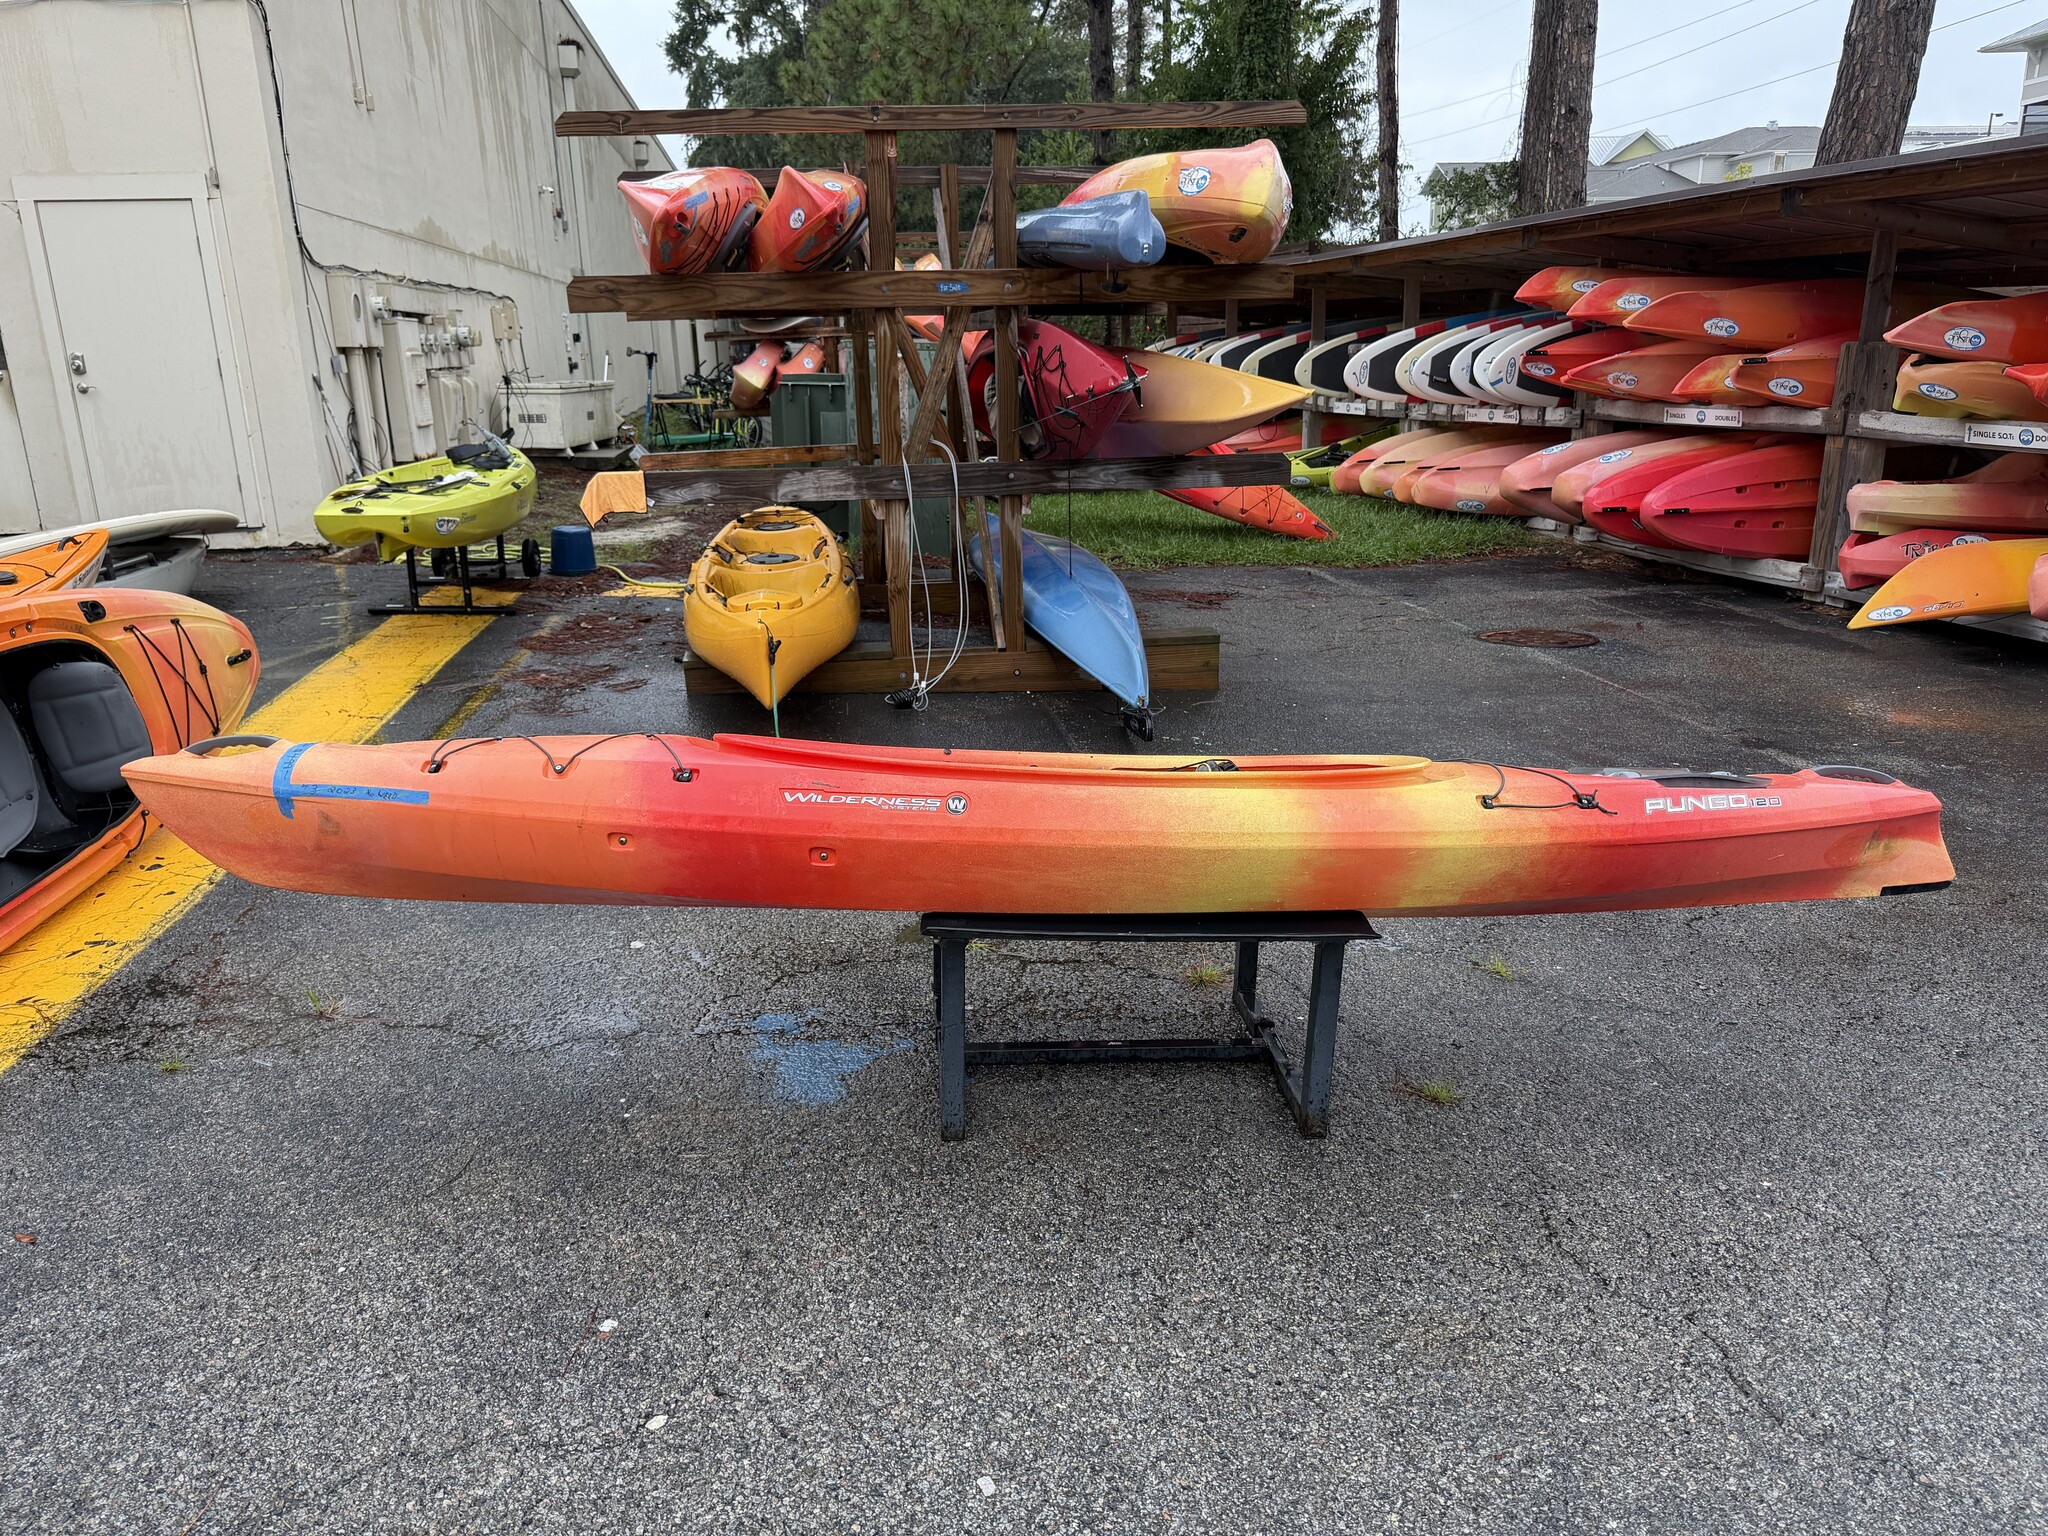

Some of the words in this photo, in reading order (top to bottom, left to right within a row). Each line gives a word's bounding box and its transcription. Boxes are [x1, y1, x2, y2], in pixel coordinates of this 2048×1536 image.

[1669, 412, 1686, 420] SINGLES
[1972, 430, 1996, 439] SINGLE
[1644, 793, 1749, 816] PUNGO
[1750, 796, 1783, 807] 120
